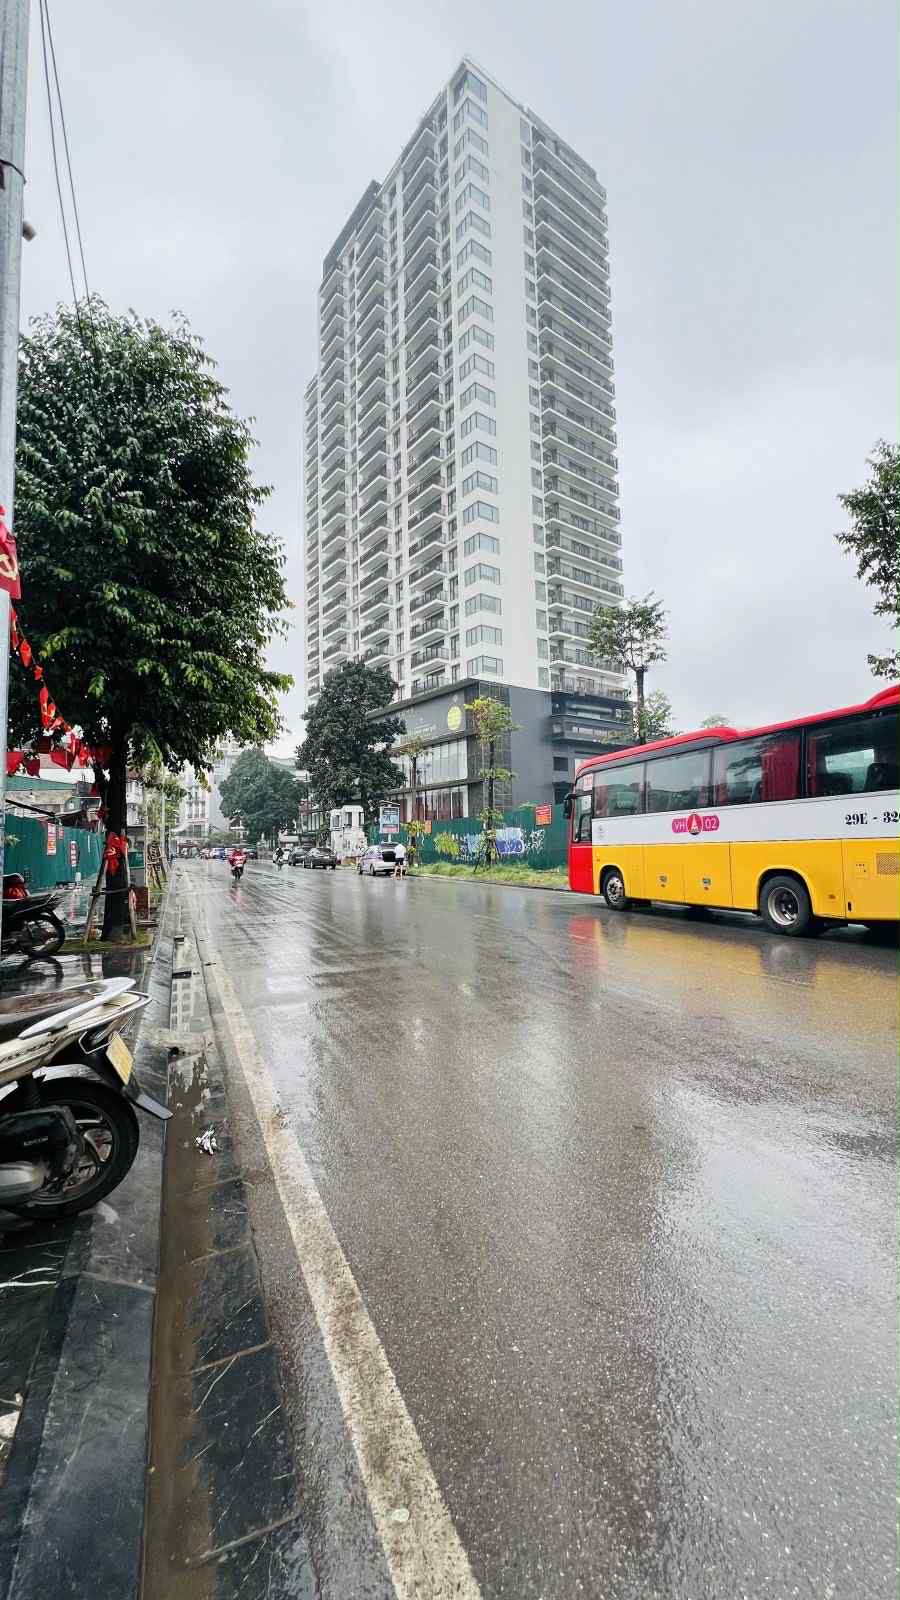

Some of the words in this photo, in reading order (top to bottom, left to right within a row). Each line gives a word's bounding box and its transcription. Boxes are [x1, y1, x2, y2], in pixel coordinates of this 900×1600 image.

[705, 817, 718, 829] 02
[845, 813, 868, 826] 29E
[883, 810, 900, 824] 32
